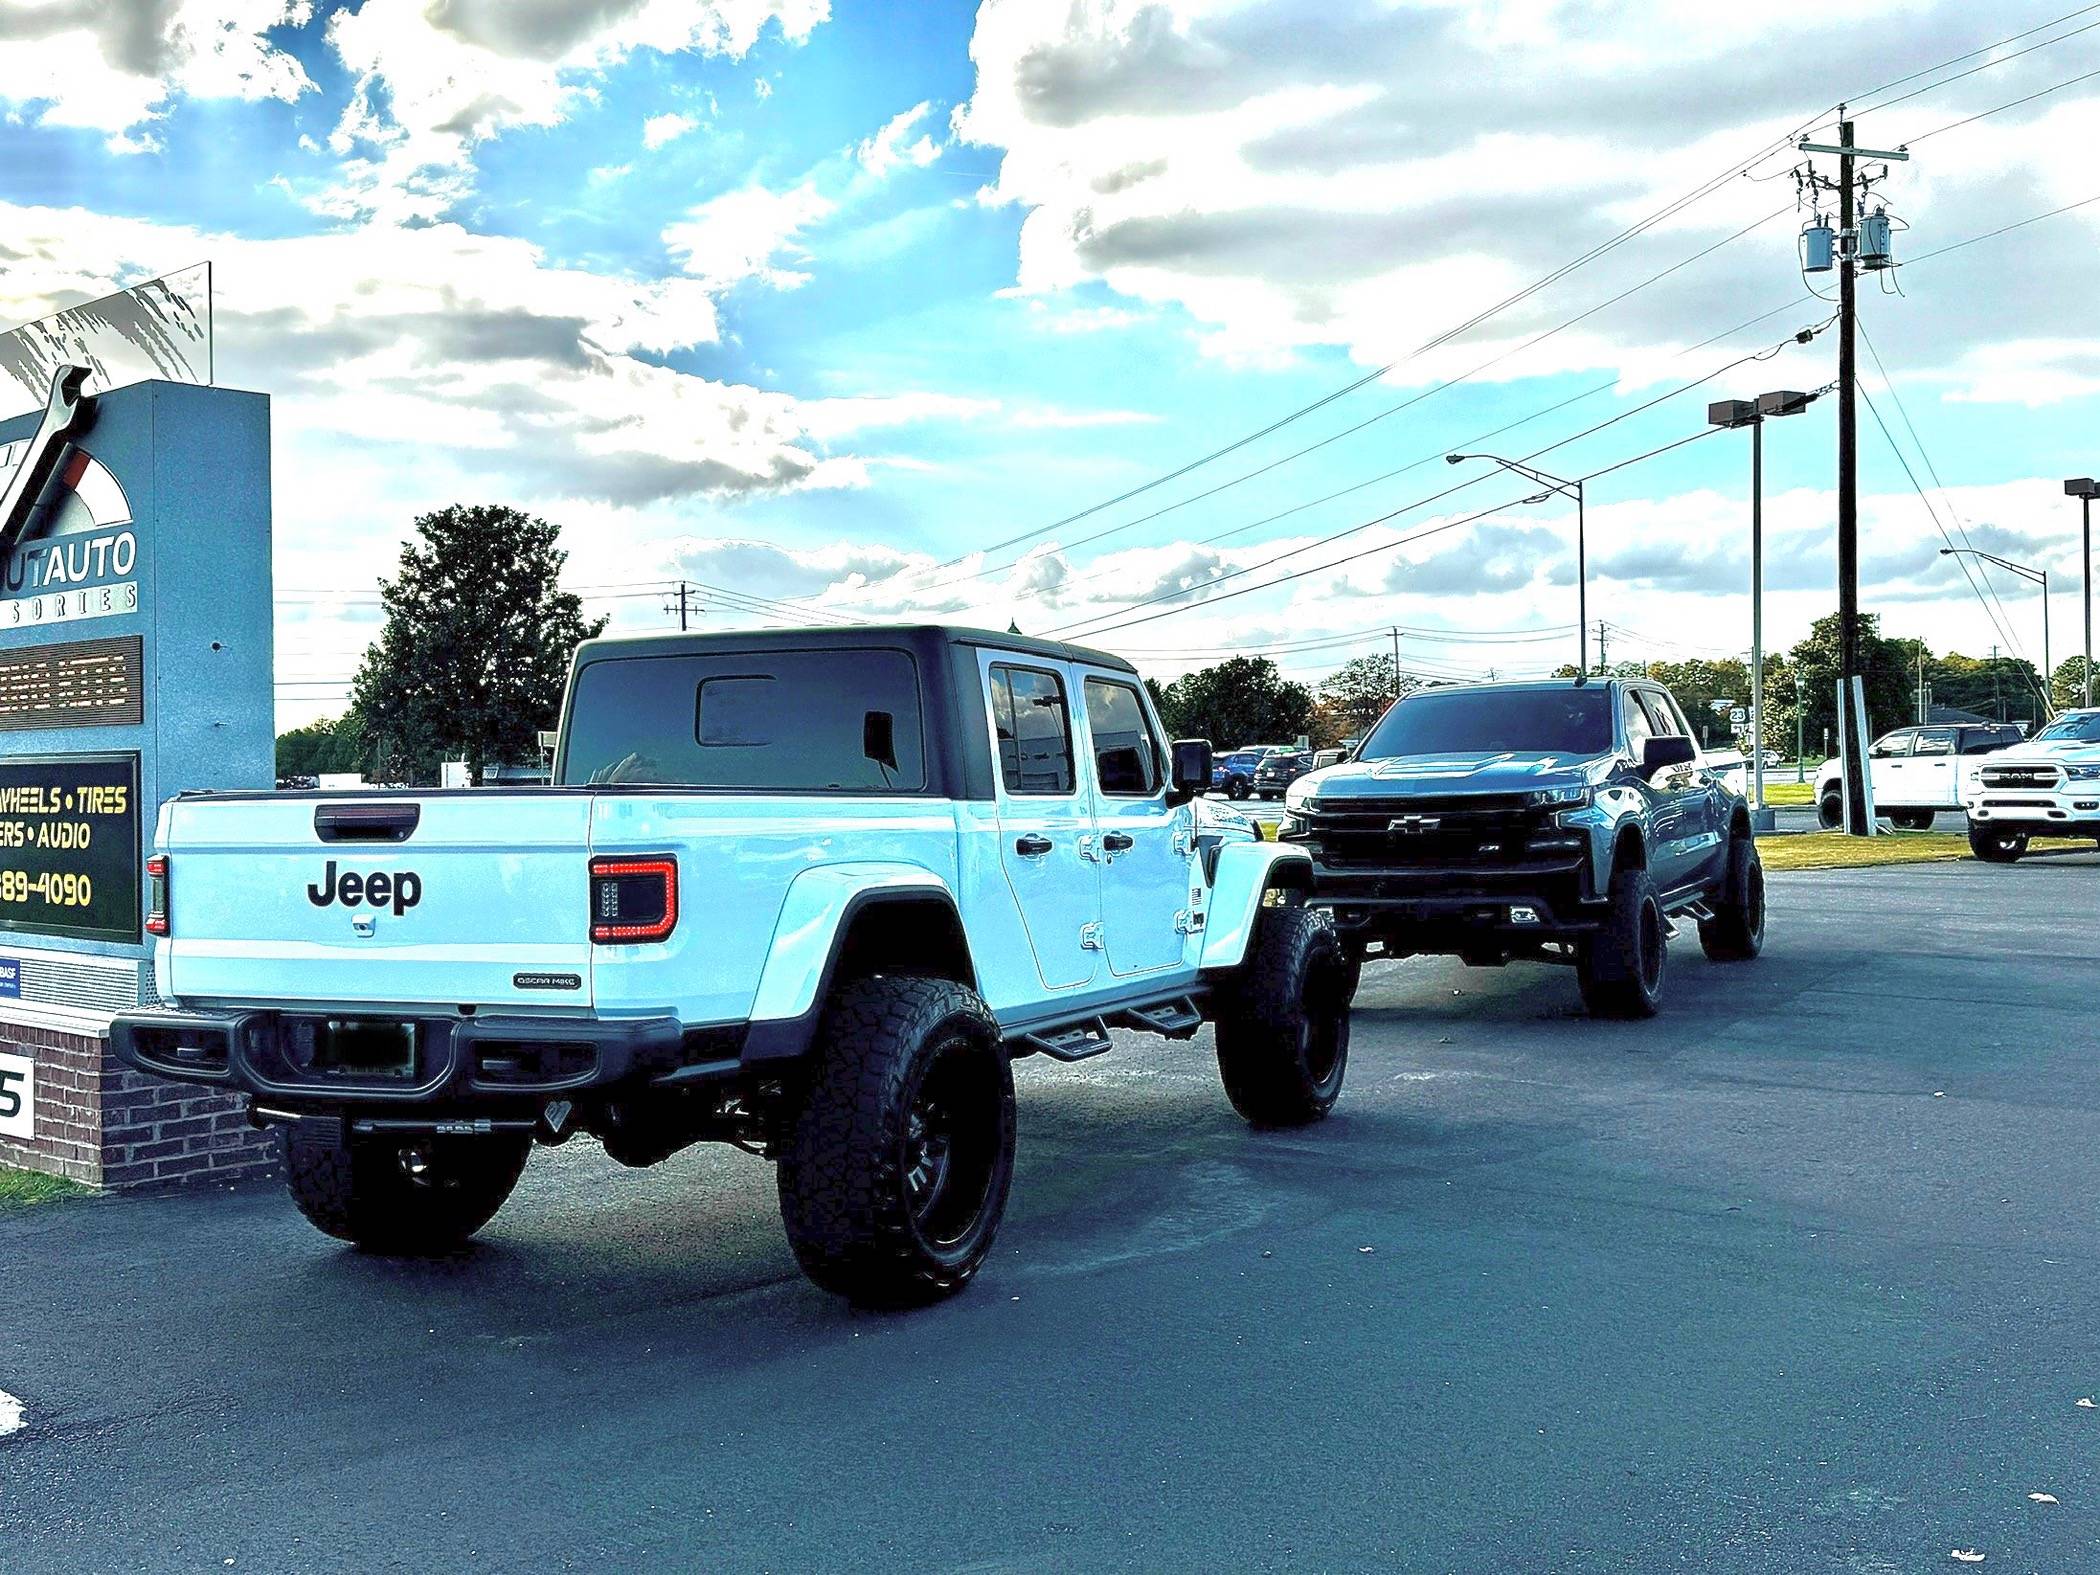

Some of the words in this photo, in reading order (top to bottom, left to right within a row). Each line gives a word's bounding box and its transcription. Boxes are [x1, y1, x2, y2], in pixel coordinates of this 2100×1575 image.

[0, 531, 136, 592] UTAUTO
[59, 656, 127, 708] KITS
[1731, 710, 1744, 720] 23
[77, 786, 127, 814] TIRES
[37, 822, 91, 849] AUDIO
[0, 870, 92, 906] 89-4090
[307, 860, 422, 916] Jeep
[517, 976, 550, 985] OSCAR
[0, 1069, 25, 1118] 5
